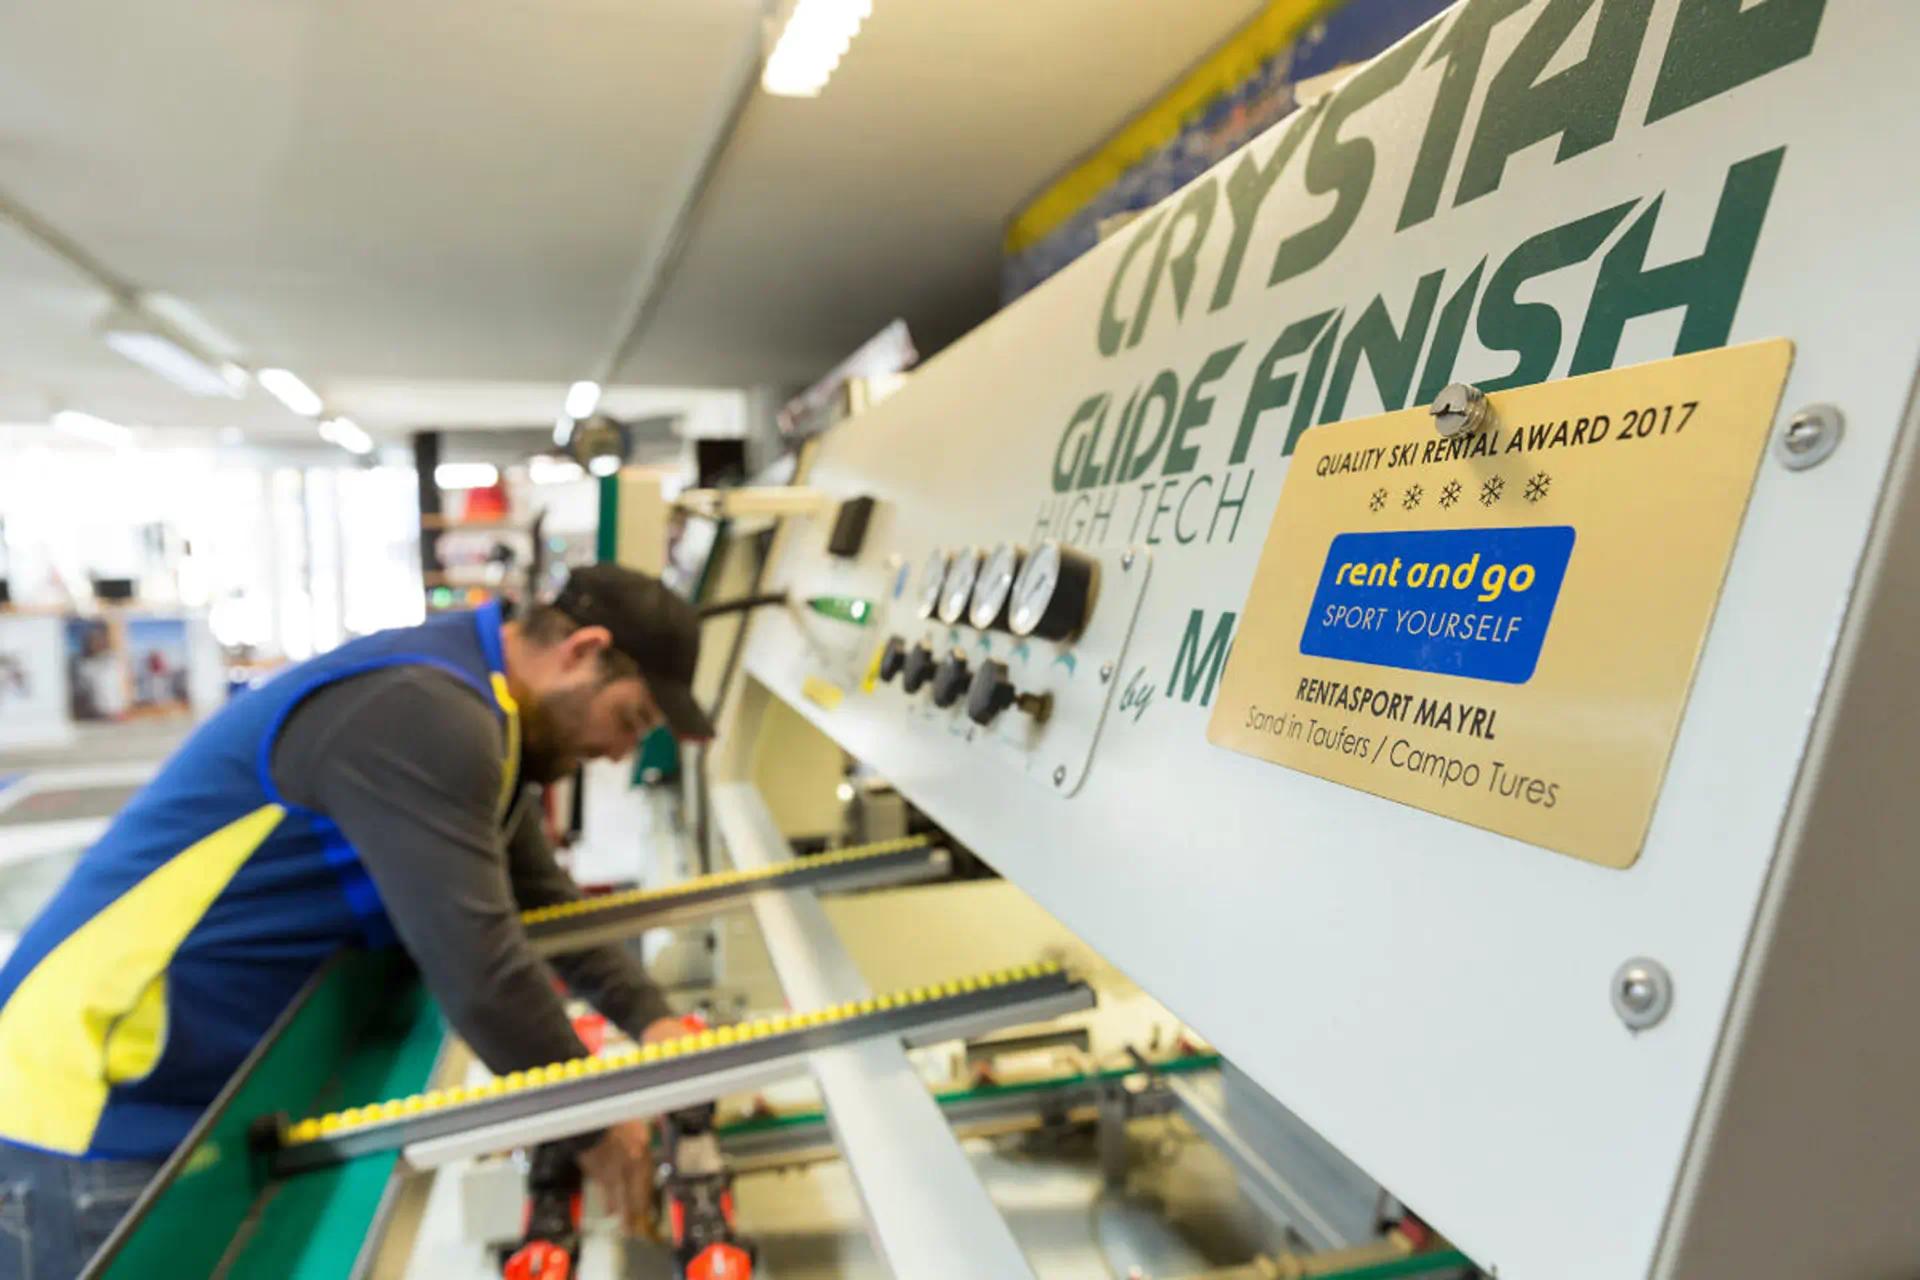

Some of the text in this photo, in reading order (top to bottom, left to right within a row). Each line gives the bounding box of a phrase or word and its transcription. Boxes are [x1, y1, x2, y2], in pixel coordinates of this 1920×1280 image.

[1052, 145, 1788, 493] GLIDE FINISH
[1315, 400, 1699, 477] QUALITY SKI RENTAL AWARD 2017
[1030, 469, 1254, 545] HIGH TECH
[1335, 553, 1536, 602] rent and go
[1322, 604, 1523, 643] SPORT YOURSELF
[1119, 665, 1156, 724] by
[1295, 677, 1498, 740] RENTASPORT MAYRL
[1245, 704, 1561, 809] Sand in Taufers / Campo Tures
